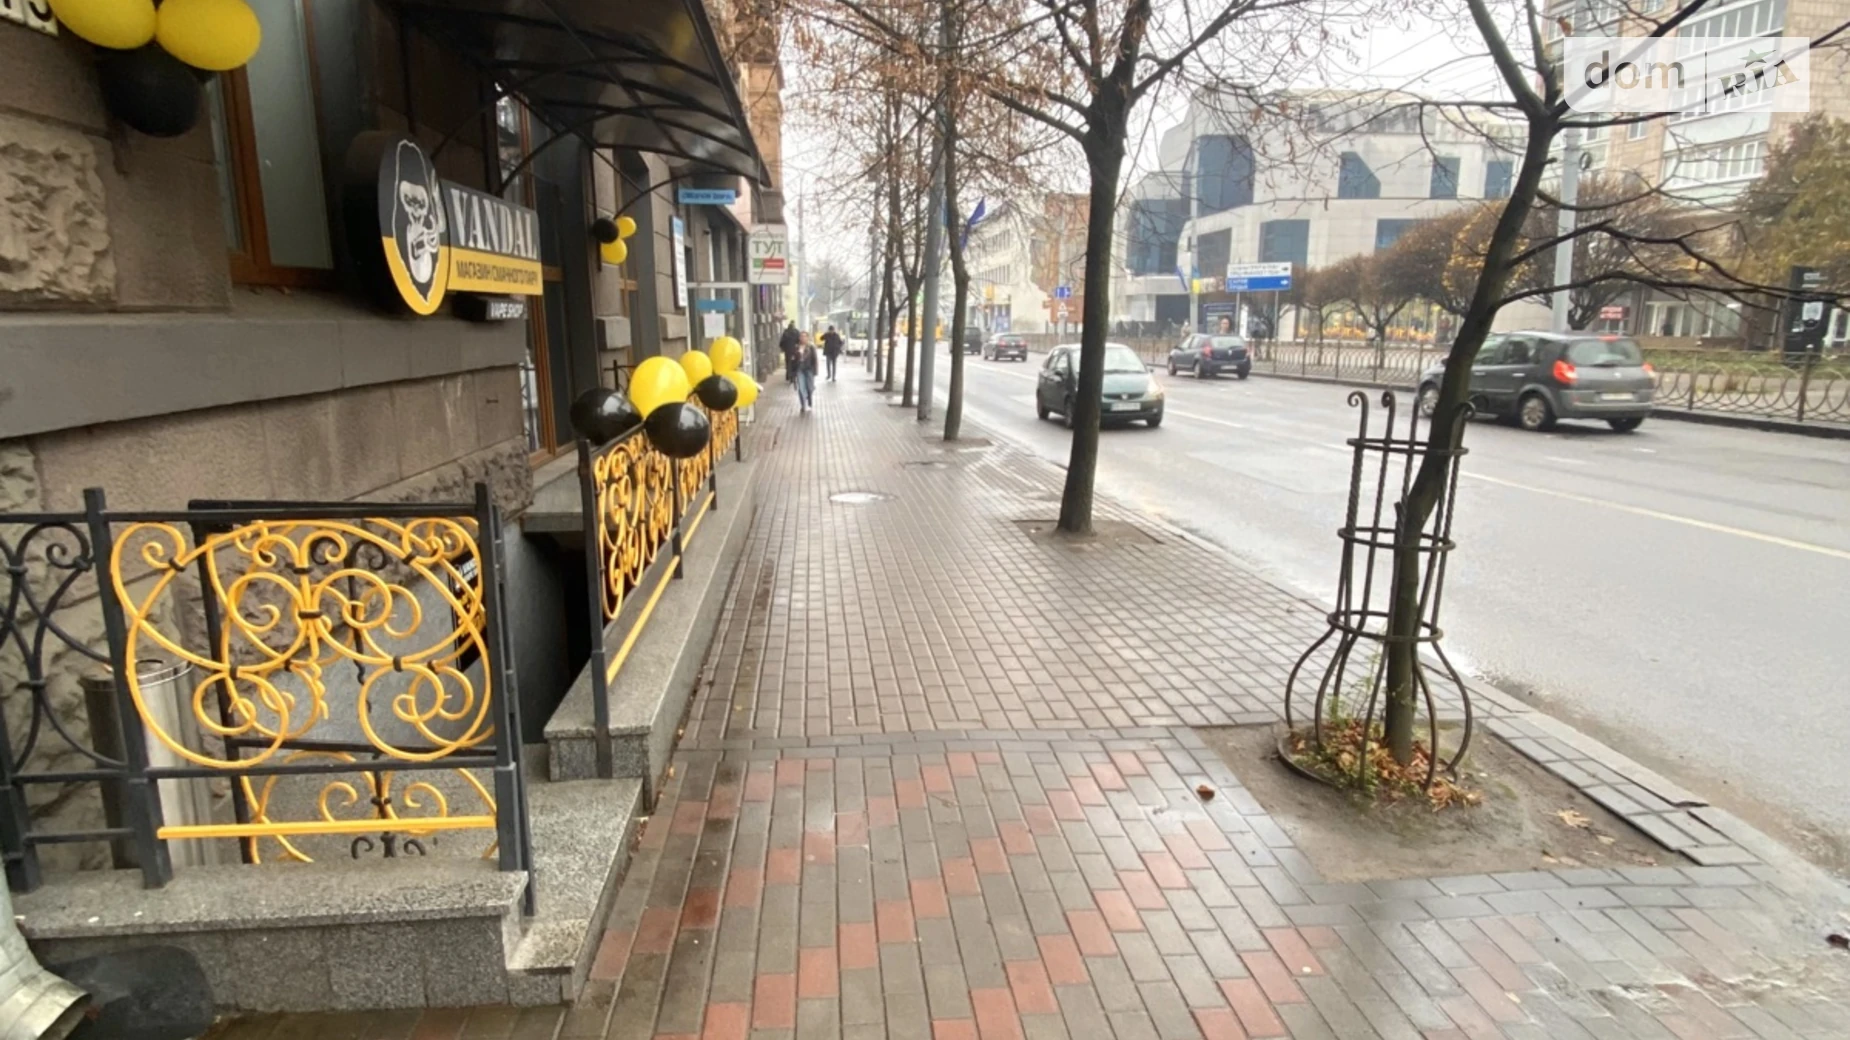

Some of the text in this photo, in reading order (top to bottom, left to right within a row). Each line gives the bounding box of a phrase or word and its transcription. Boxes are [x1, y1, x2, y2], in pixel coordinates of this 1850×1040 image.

[451, 188, 537, 260] VANDAL
[752, 241, 784, 254] ТУТ
[456, 260, 490, 279] МАГАЗИН
